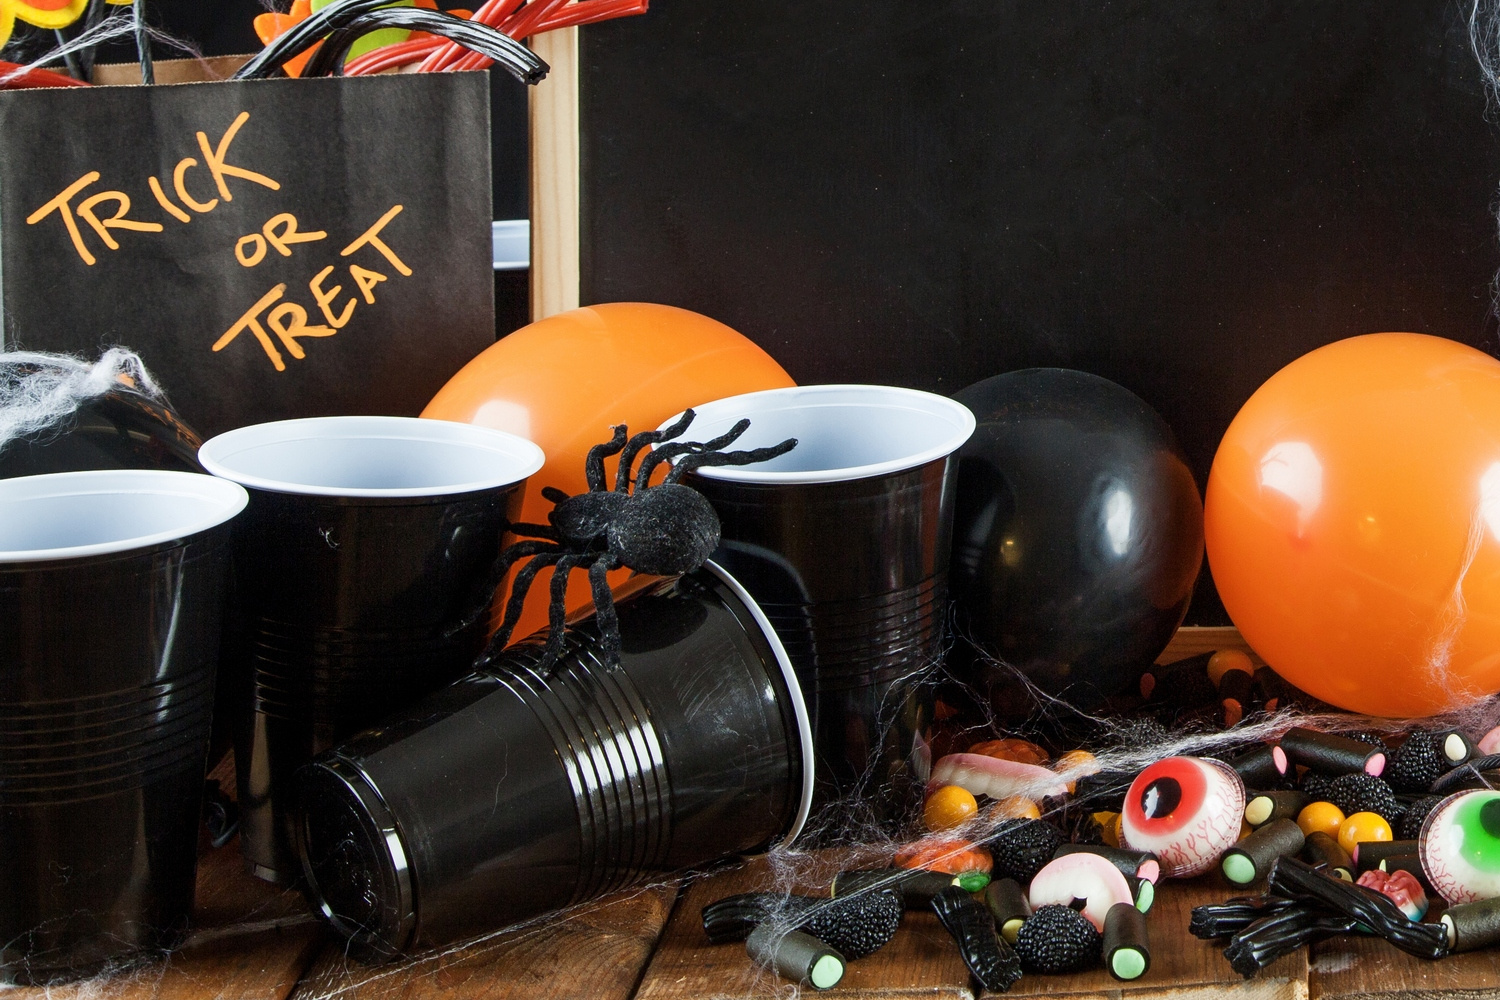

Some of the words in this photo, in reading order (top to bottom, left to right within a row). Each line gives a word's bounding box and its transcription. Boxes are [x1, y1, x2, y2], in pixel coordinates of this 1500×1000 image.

[27, 111, 281, 266] TRICK
[234, 212, 328, 268] OR
[211, 204, 413, 372] TREAT
